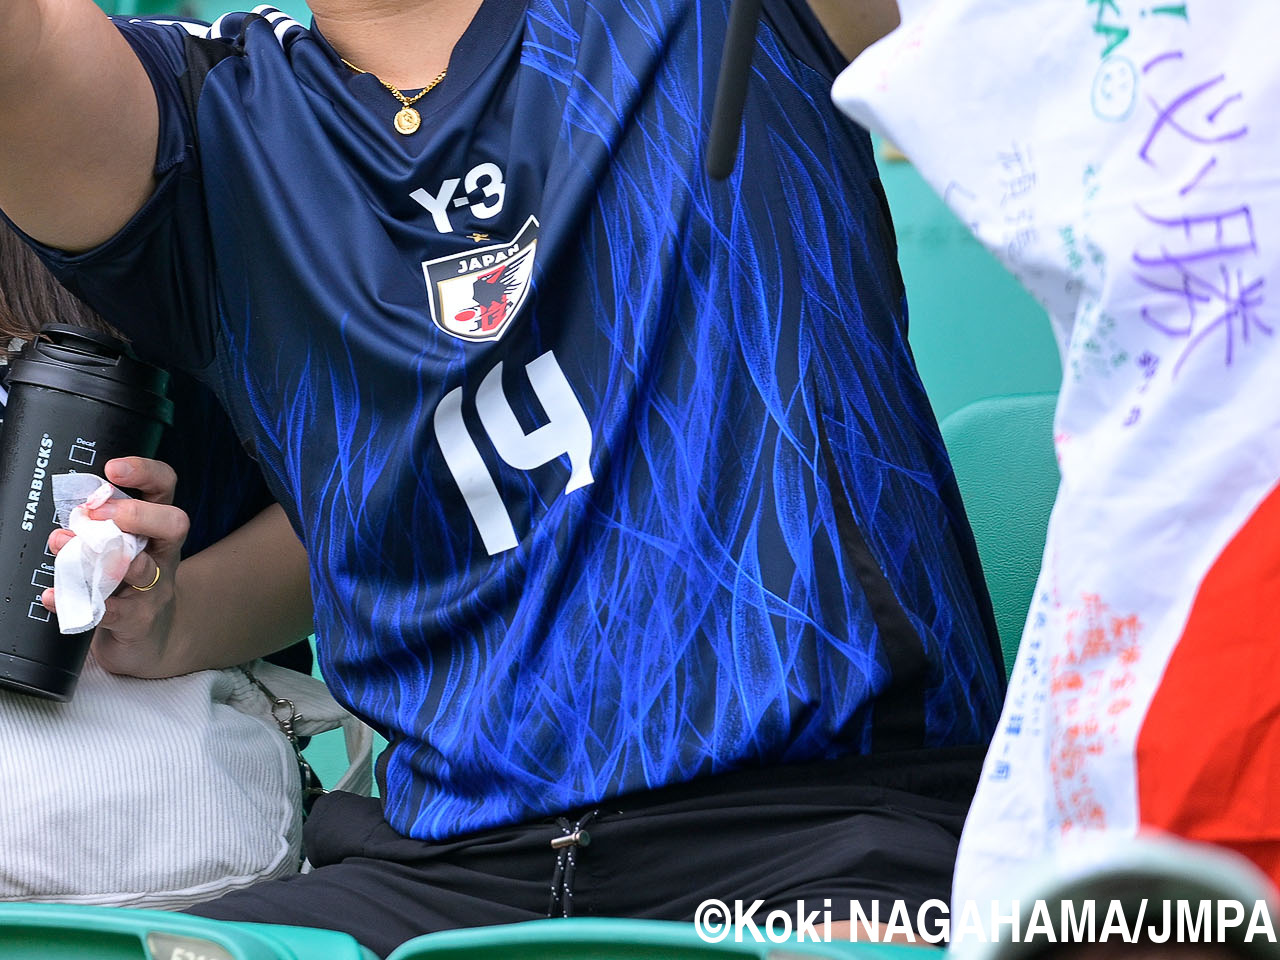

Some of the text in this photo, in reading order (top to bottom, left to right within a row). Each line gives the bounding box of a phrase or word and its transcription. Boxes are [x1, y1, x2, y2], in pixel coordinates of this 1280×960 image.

[409, 162, 506, 233] Y-3
[1132, 50, 1275, 380] 必勝
[457, 243, 520, 275] JAPAN
[21, 433, 54, 532] STARBUCKS
[76, 437, 97, 447] Decaf
[433, 349, 595, 556] 14
